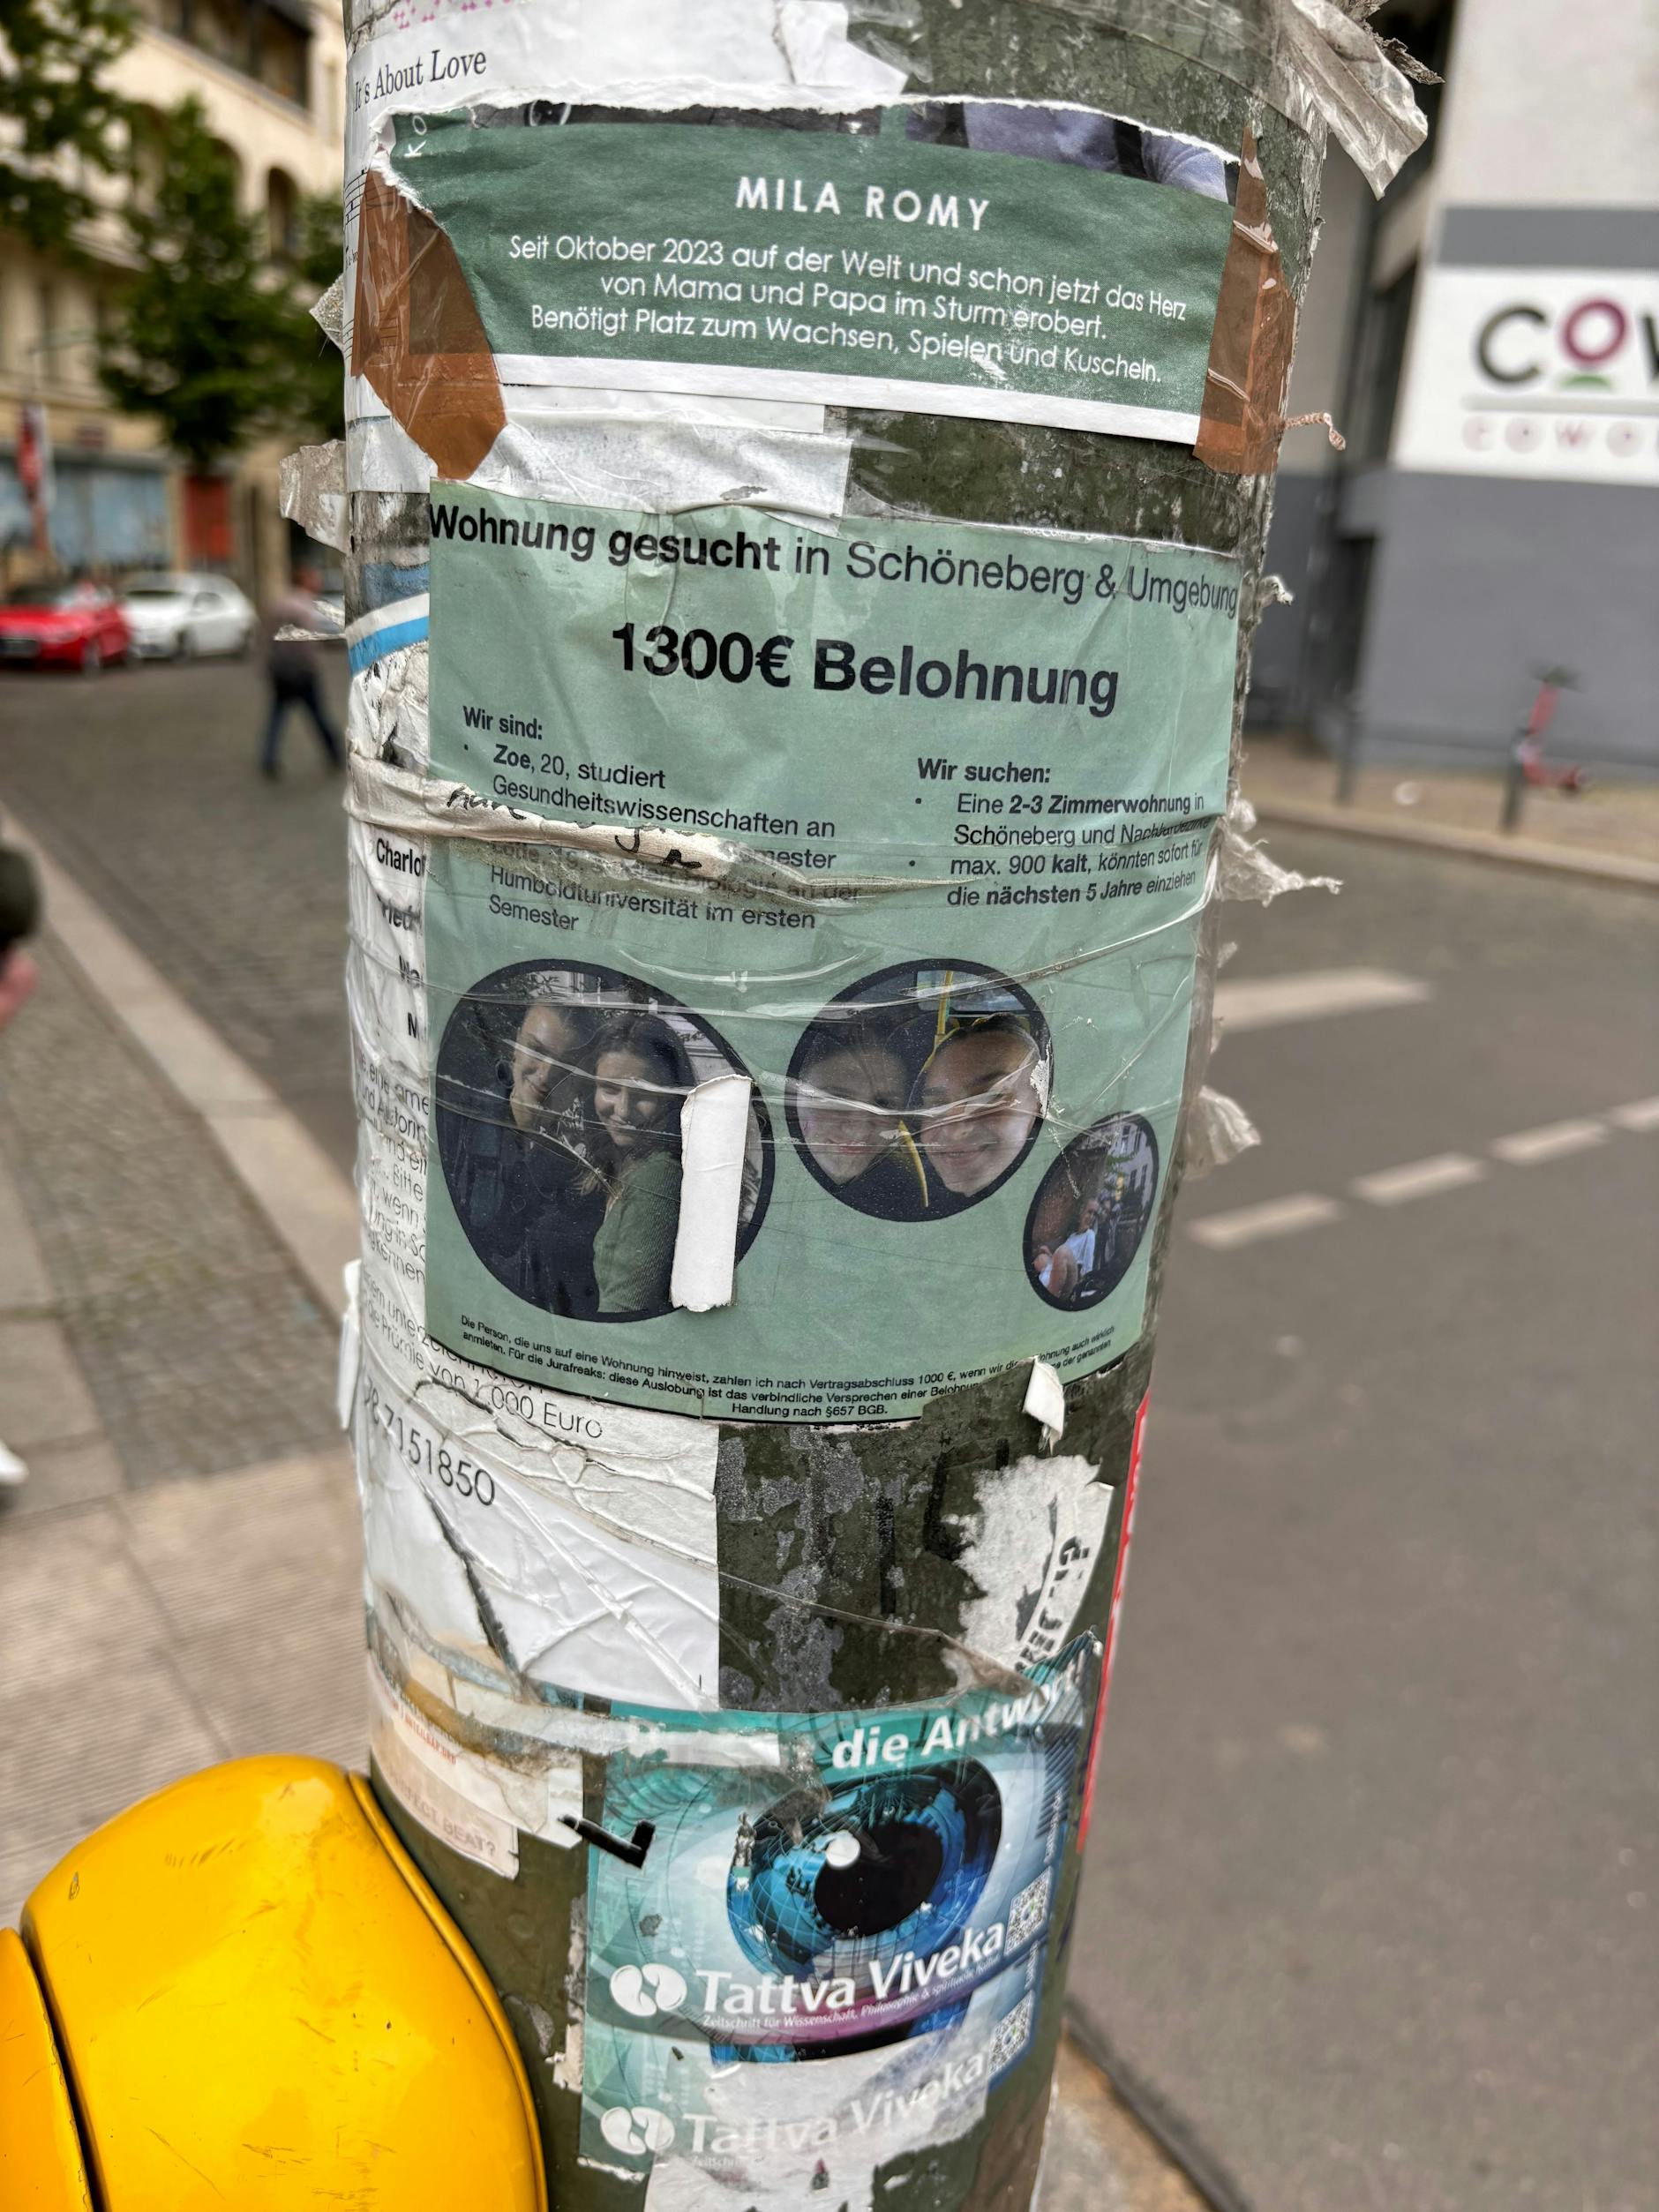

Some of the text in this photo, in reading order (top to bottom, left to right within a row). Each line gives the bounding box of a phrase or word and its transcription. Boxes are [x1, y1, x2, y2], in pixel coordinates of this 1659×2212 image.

[374, 56, 424, 100] About
[430, 49, 486, 83] Love
[736, 176, 989, 231] MILA ROMY
[509, 236, 1187, 321] Seit Oktober 2023 auf der Welt und schon jetzt das Herz
[601, 273, 1107, 340] von Mama und Papa im Sturm erobert.
[531, 304, 1162, 383] Benötigt Platz zum Wachsen, Spielen und Kuscheln.
[1460, 415, 1659, 459] COWO
[430, 505, 1236, 619] Wohnung gesucht in Schöneberg & Umgebung
[612, 622, 1118, 717] 1300€ Belohnung
[463, 706, 543, 740] Wir sind:
[493, 745, 665, 789] Zoe, 20, studiert
[918, 758, 1050, 784] Wir suchen:
[493, 775, 799, 836] Gesundheitswissenschaften
[807, 821, 836, 837] an
[957, 792, 1205, 815] Eine 2-3 Zimmerwohnung in
[950, 839, 1203, 875] max. 900 kalt, könnten sofort für
[954, 824, 1075, 847] Schöneberg
[1082, 825, 1115, 844] und
[490, 894, 580, 931] Semester
[491, 865, 698, 919] Humboldtuniversität
[706, 902, 733, 922] im
[742, 907, 815, 929] ersten
[947, 871, 1196, 905] die nächsten 5 Jahre einziehen
[462, 1315, 476, 1329] Die
[477, 1322, 511, 1344] Person,
[514, 1337, 530, 1348] die
[533, 1342, 552, 1353] uns
[555, 1347, 573, 1359] auf
[575, 1351, 598, 1363] eine
[601, 1355, 654, 1377] Wohnung
[658, 1367, 709, 1384] hinweist,
[713, 1375, 751, 1387] zahlen
[755, 1377, 773, 1388] ich
[777, 1378, 805, 1389] nach
[809, 1376, 914, 1391] Vertragsabschluss
[919, 1372, 944, 1384] 1000
[959, 1367, 986, 1379] wenn
[989, 1362, 1003, 1374] wir
[462, 1331, 506, 1355] anmieten.
[508, 1347, 526, 1360] Für
[528, 1353, 543, 1365] die
[546, 1359, 606, 1380] Jurafreaks:
[609, 1373, 639, 1386] diese
[642, 1378, 705, 1399] Auslobung
[709, 1388, 722, 1398] ist
[726, 1388, 747, 1400] das
[752, 1391, 822, 1404] verbindliche
[827, 1391, 897, 1405] Versprechen
[901, 1389, 927, 1399] einer
[430, 1361, 466, 1391] von
[544, 1401, 604, 1439] Euro
[732, 1403, 888, 1418] Handlung nach §657 BGB.
[385, 1404, 495, 1506] 7151850
[832, 1726, 909, 1769] die
[695, 1968, 856, 2016] Tattva
[868, 1922, 1006, 2000] Viveka
